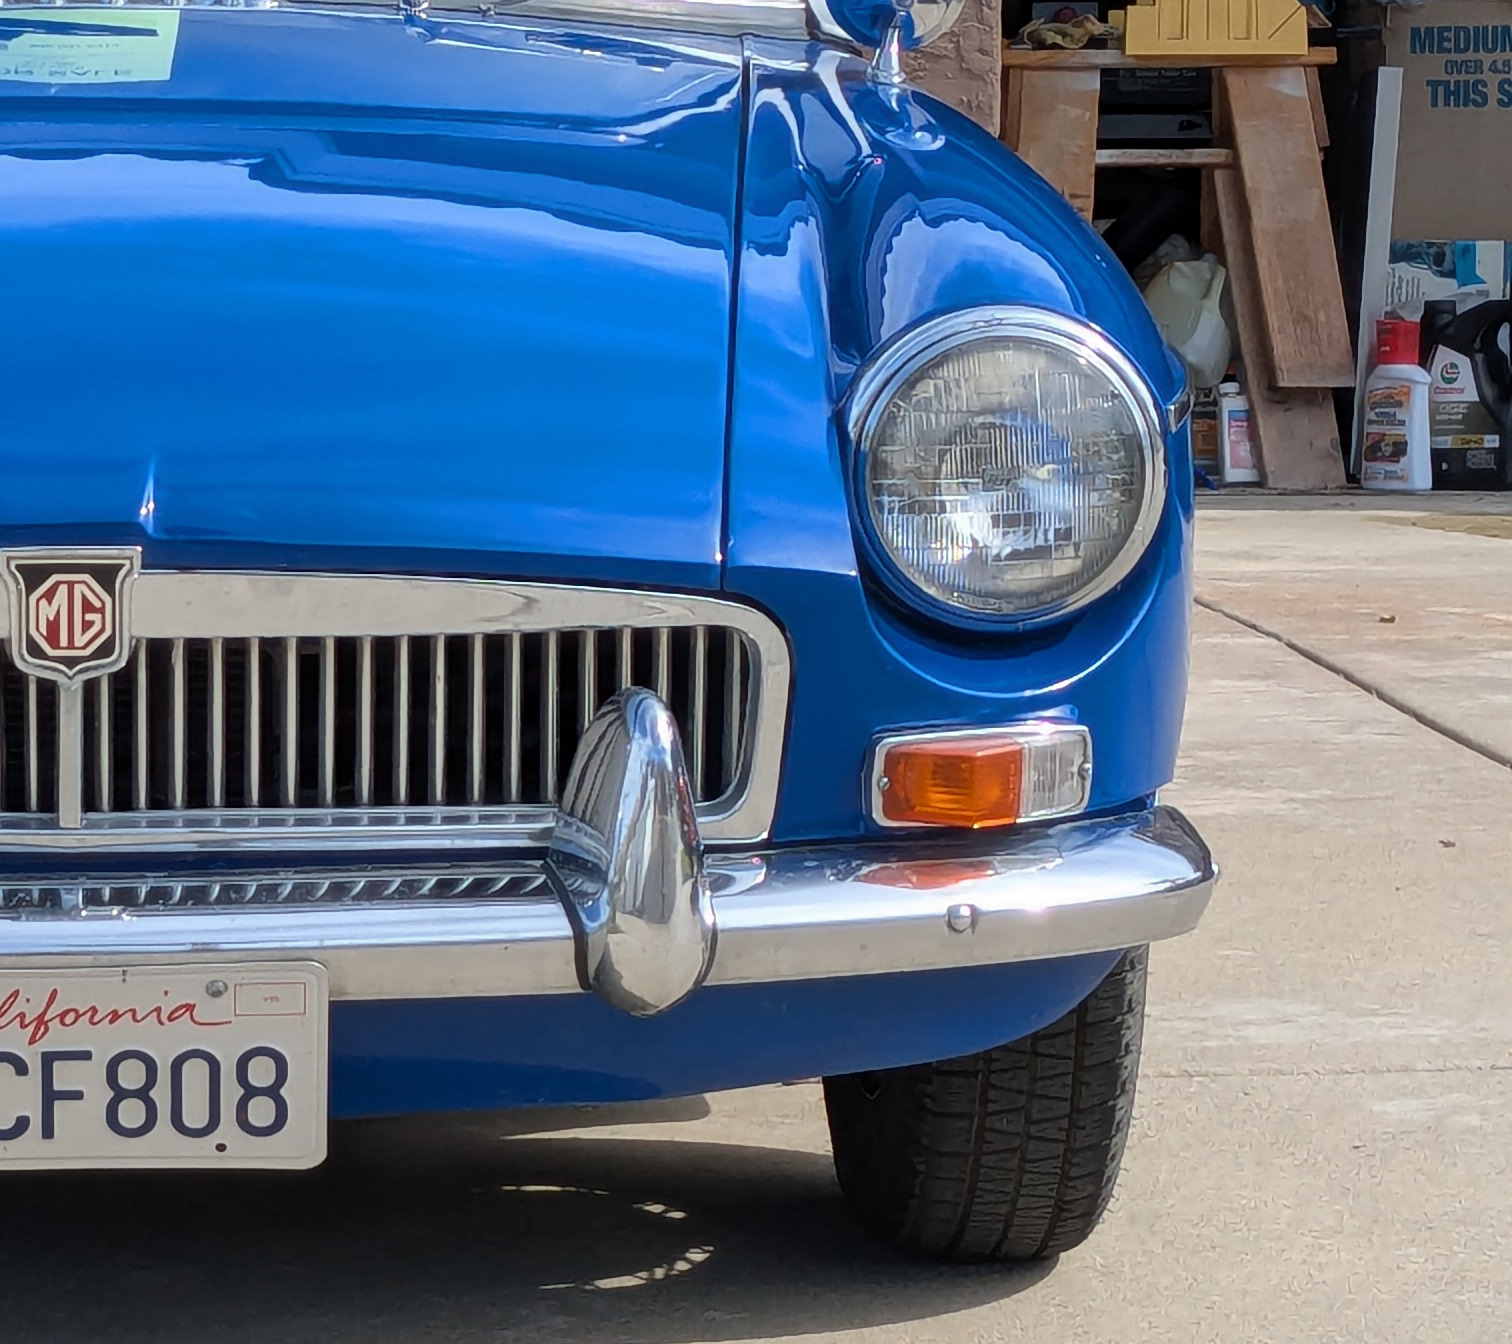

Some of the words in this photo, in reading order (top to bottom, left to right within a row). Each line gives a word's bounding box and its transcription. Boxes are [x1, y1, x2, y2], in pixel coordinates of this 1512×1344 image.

[1444, 59, 1484, 75] OVER
[1426, 79, 1488, 108] THIS
[38, 583, 103, 648] MG
